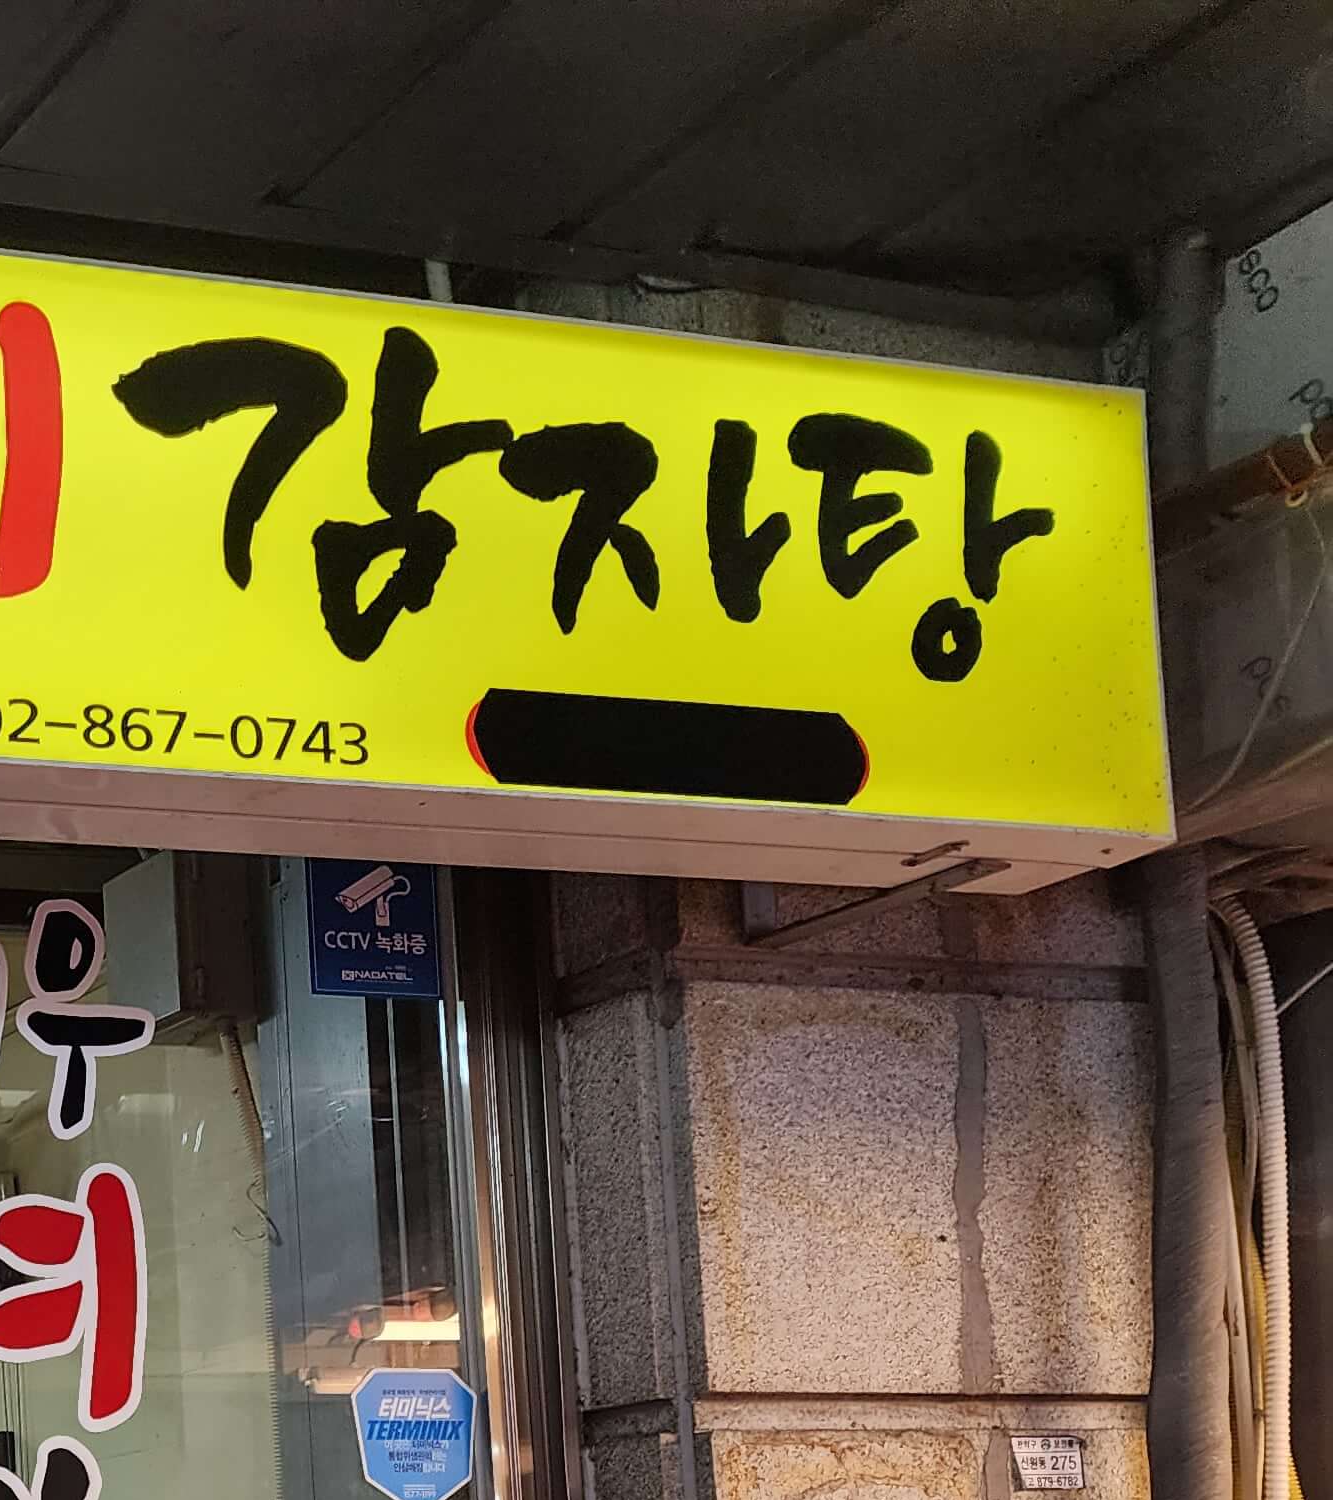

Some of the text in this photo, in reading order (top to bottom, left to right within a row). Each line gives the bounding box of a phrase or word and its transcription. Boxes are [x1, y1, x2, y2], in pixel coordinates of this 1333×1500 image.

[112, 326, 1054, 682] 감자탕
[324, 930, 428, 956] CCTV 녹화중
[378, 1397, 452, 1420] 터미닉스
[365, 1420, 465, 1441] TERMINIX
[1050, 1455, 1077, 1471] 275
